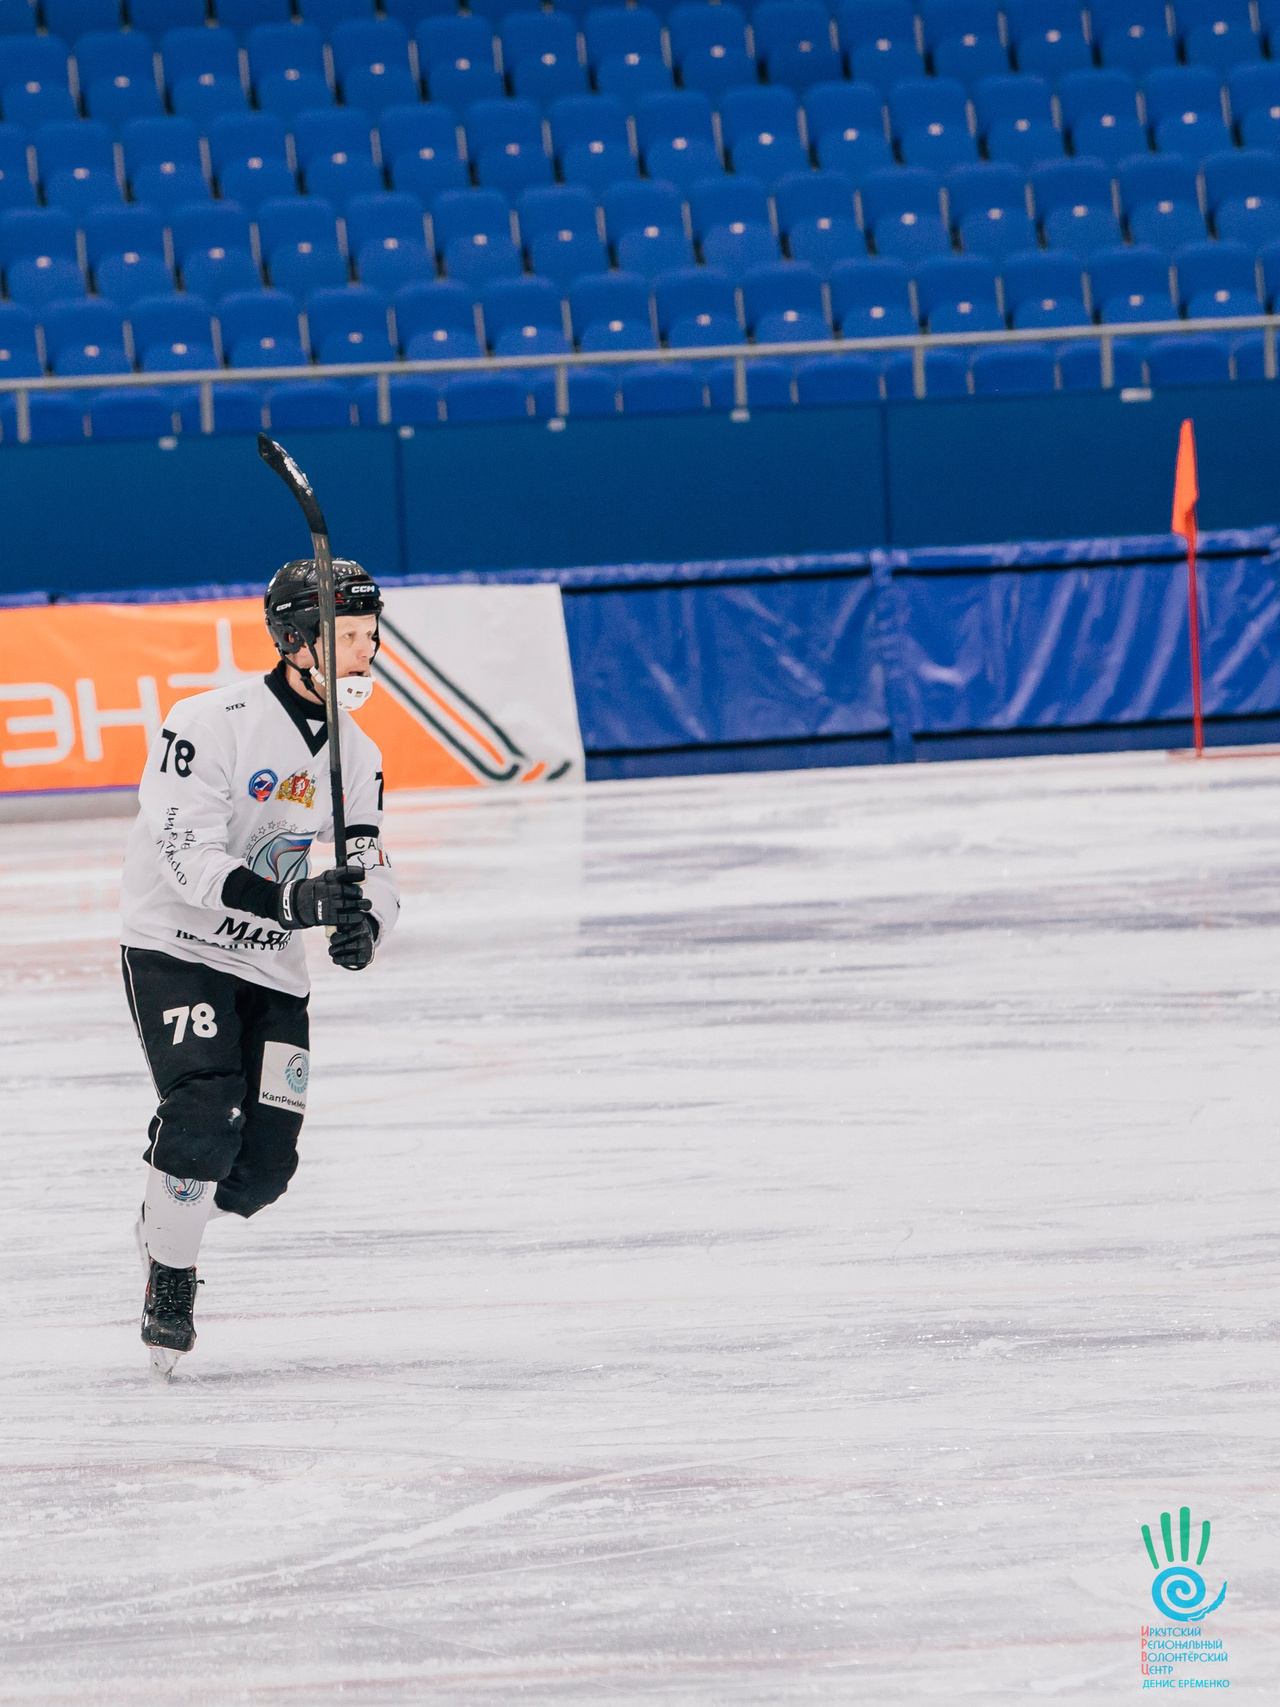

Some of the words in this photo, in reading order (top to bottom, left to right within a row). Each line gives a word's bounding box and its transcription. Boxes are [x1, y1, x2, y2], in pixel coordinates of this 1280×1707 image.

[351, 585, 375, 593] CCM
[276, 602, 291, 611] CCM
[224, 701, 246, 711] STEX
[160, 728, 195, 778] 78
[162, 1003, 218, 1046] 78
